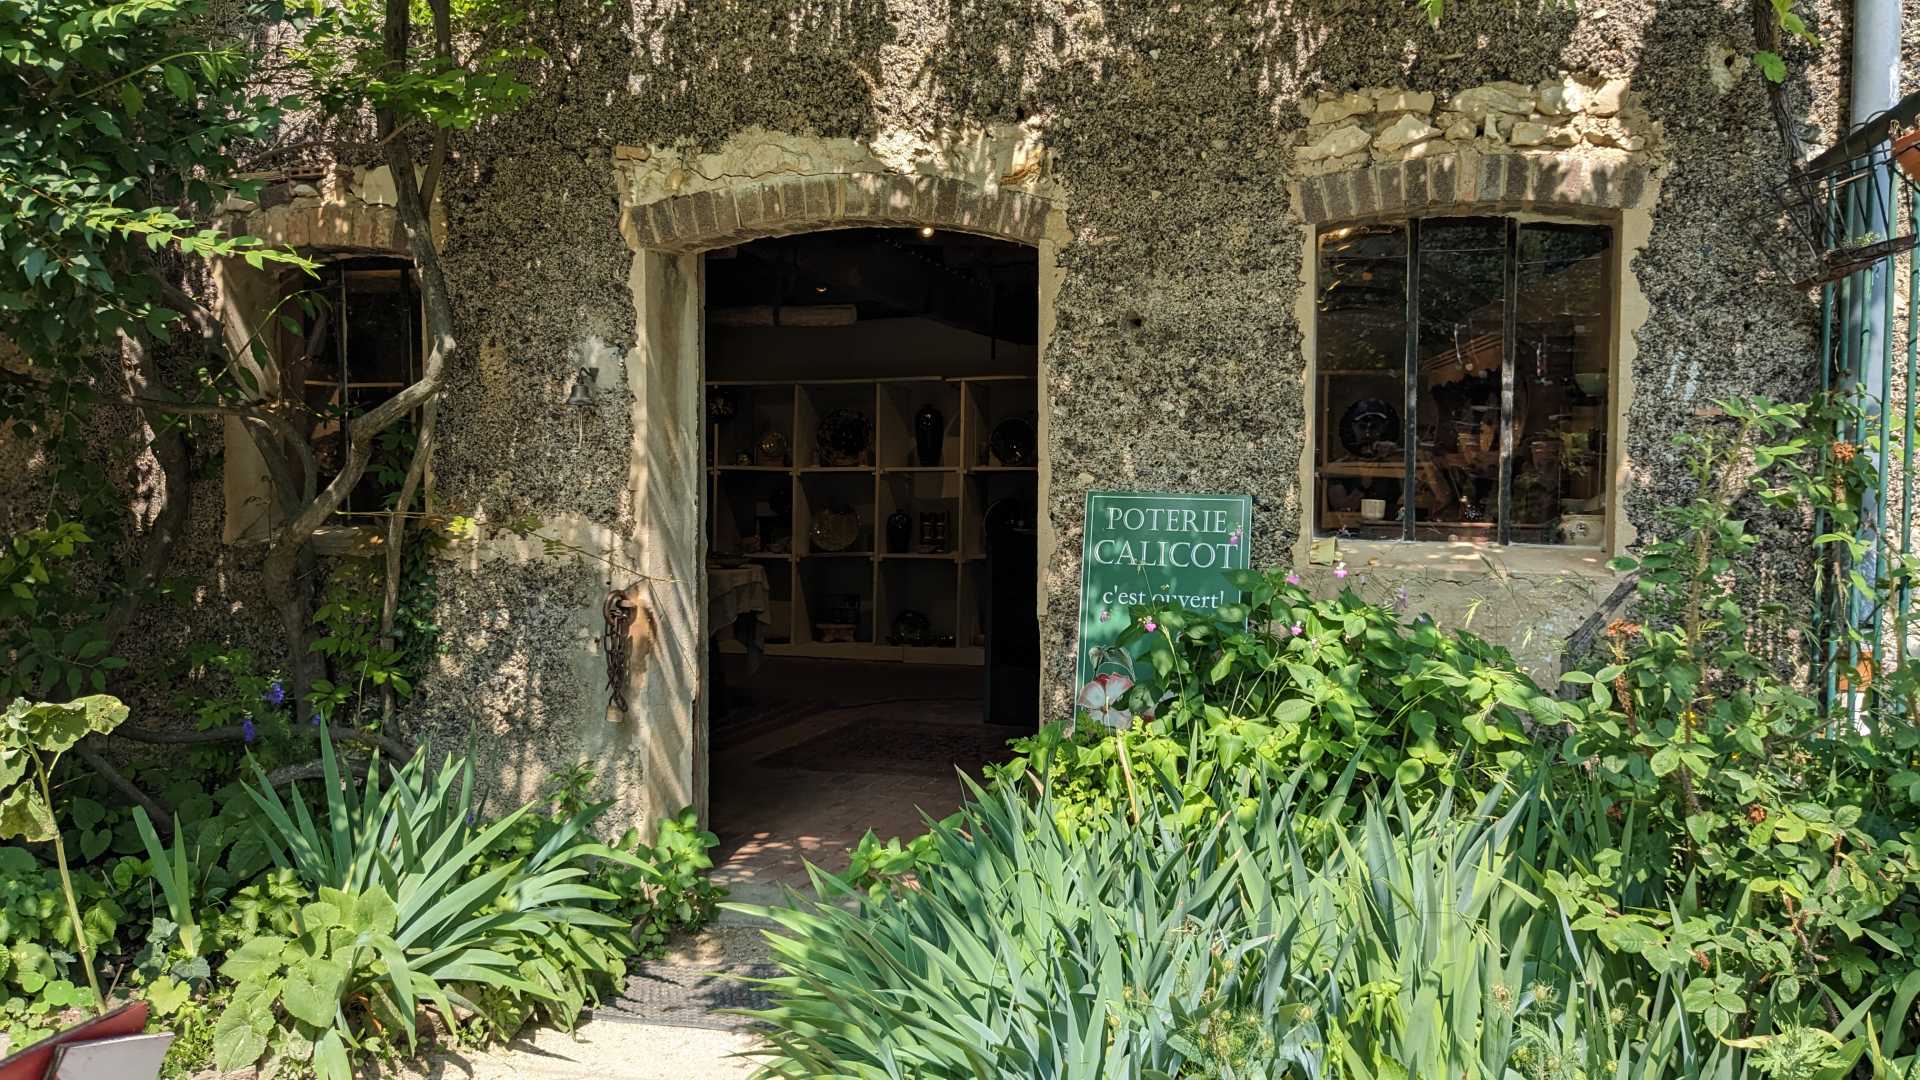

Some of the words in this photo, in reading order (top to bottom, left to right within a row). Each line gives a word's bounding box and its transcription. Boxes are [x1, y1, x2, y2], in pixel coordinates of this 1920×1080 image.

[1105, 507, 1227, 533] POTERIE
[1093, 539, 1239, 569] CALICOT
[1102, 585, 1147, 605] c'est
